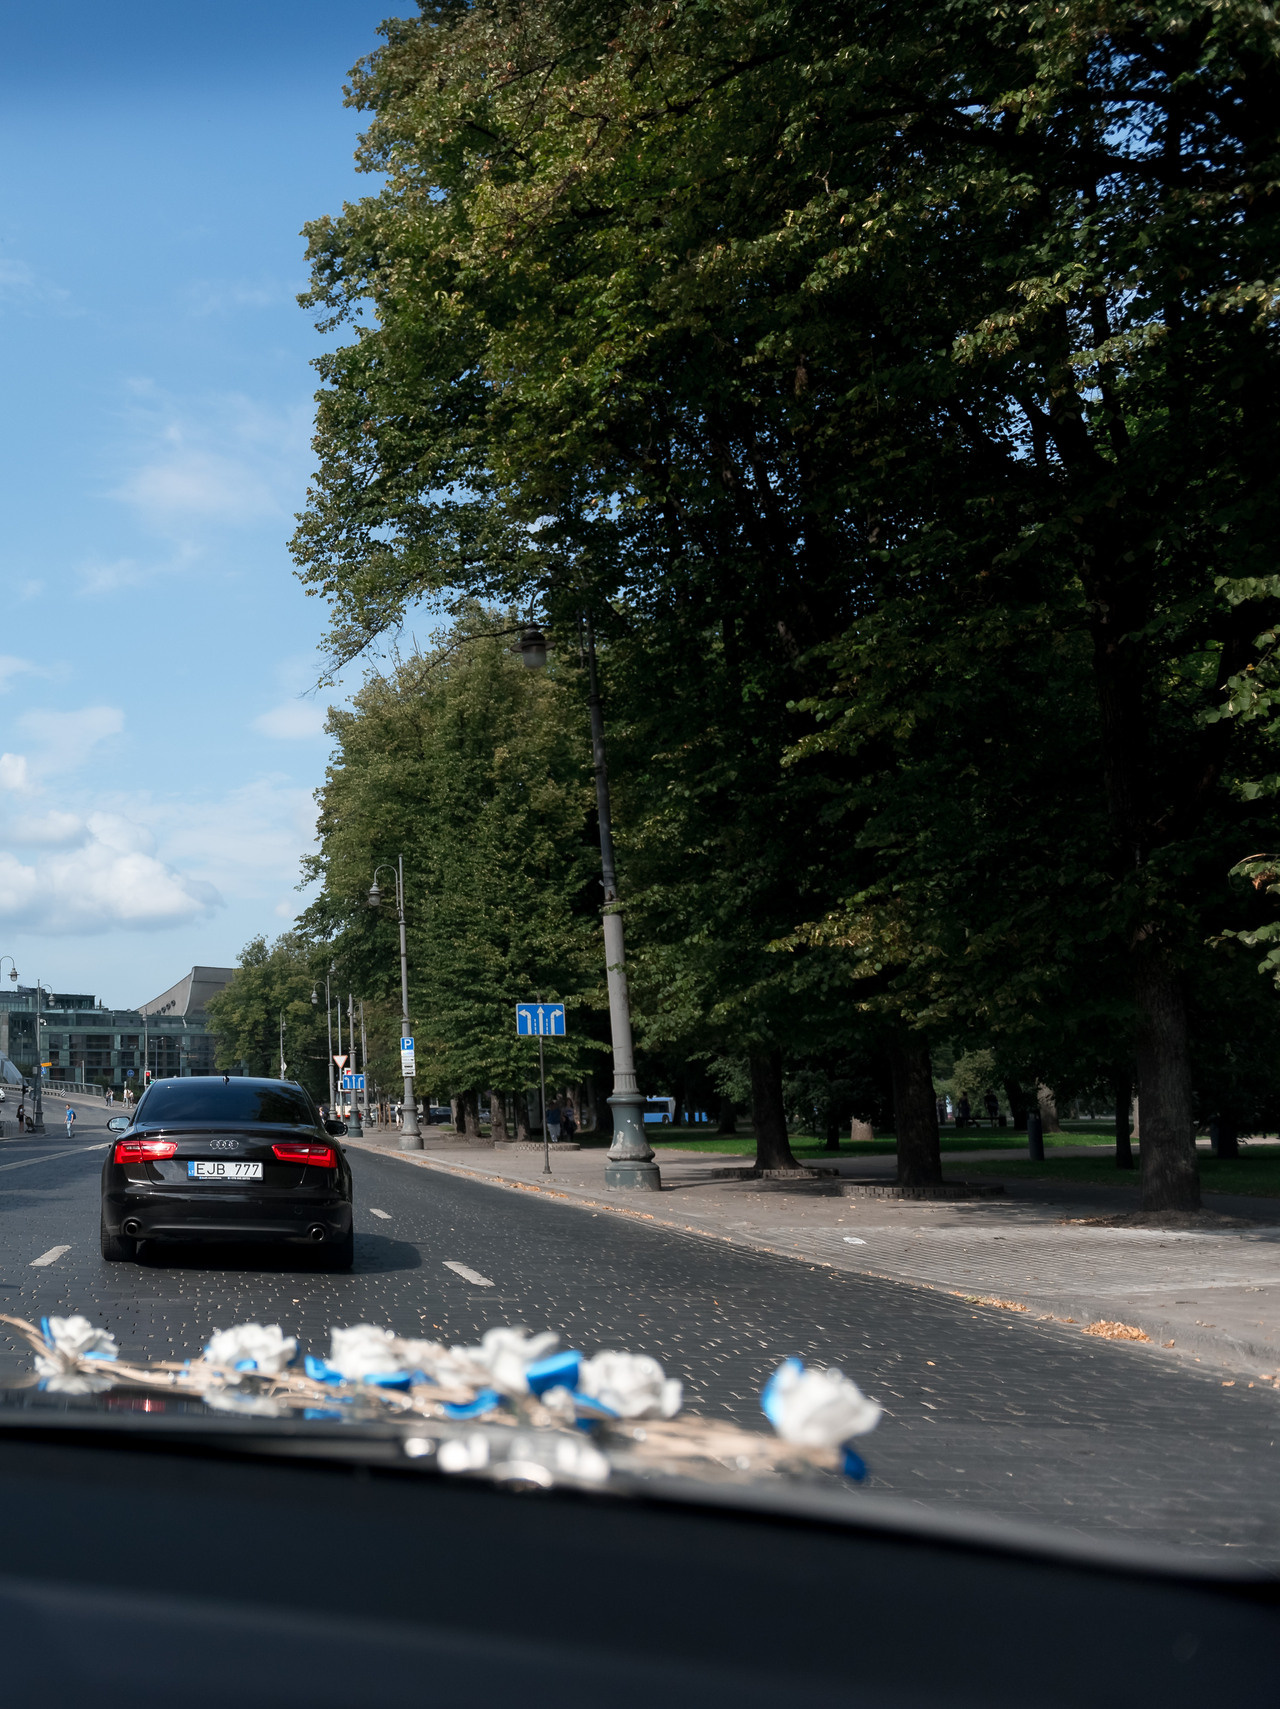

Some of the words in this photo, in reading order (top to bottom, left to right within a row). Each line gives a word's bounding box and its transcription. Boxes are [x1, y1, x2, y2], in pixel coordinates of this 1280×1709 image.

[404, 1039, 412, 1049] P
[196, 1163, 225, 1175] EJB
[235, 1163, 260, 1176] 777
